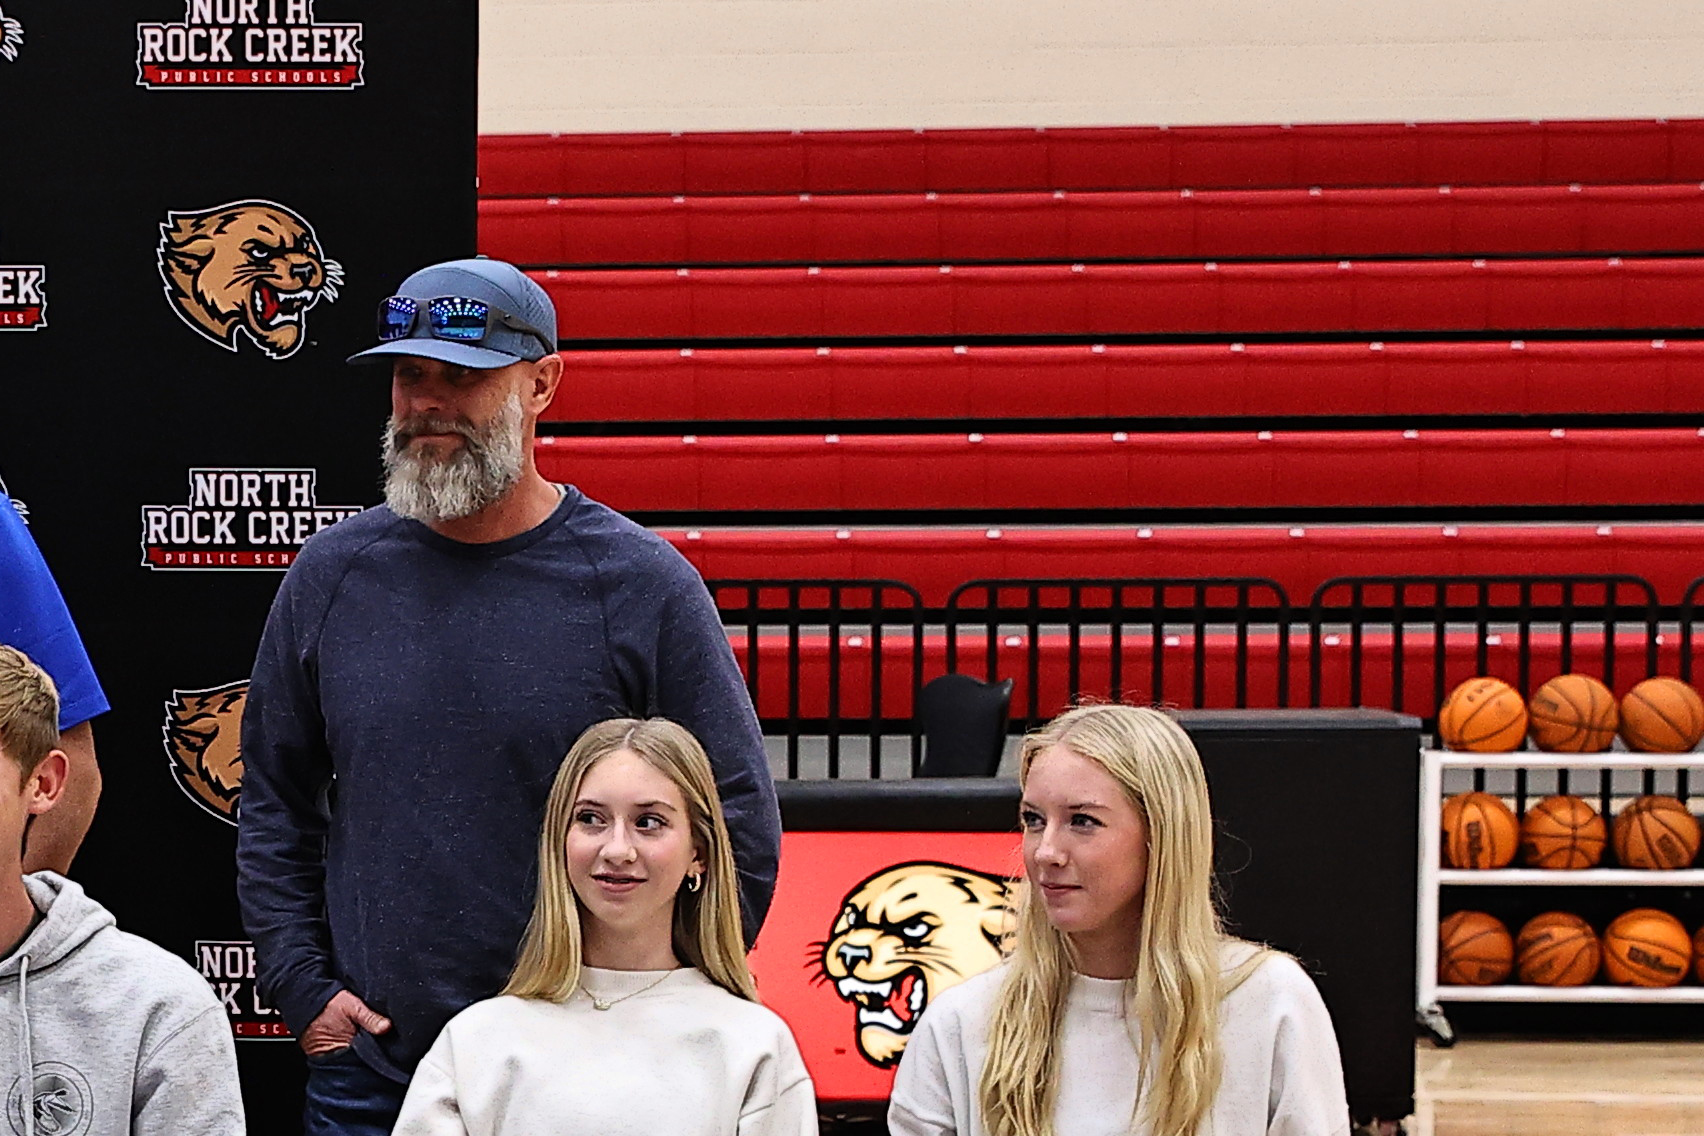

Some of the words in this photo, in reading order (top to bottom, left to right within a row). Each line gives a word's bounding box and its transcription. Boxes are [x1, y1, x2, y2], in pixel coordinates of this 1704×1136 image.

[190, 0, 309, 25] NORTH
[143, 28, 233, 62] ROCK
[245, 28, 358, 62] CREEK
[160, 71, 235, 83] PUBLIC
[251, 71, 342, 83] SCHOOLS
[194, 473, 311, 507] NORTH
[147, 511, 236, 544] ROCK
[165, 553, 238, 564] PUBLIC
